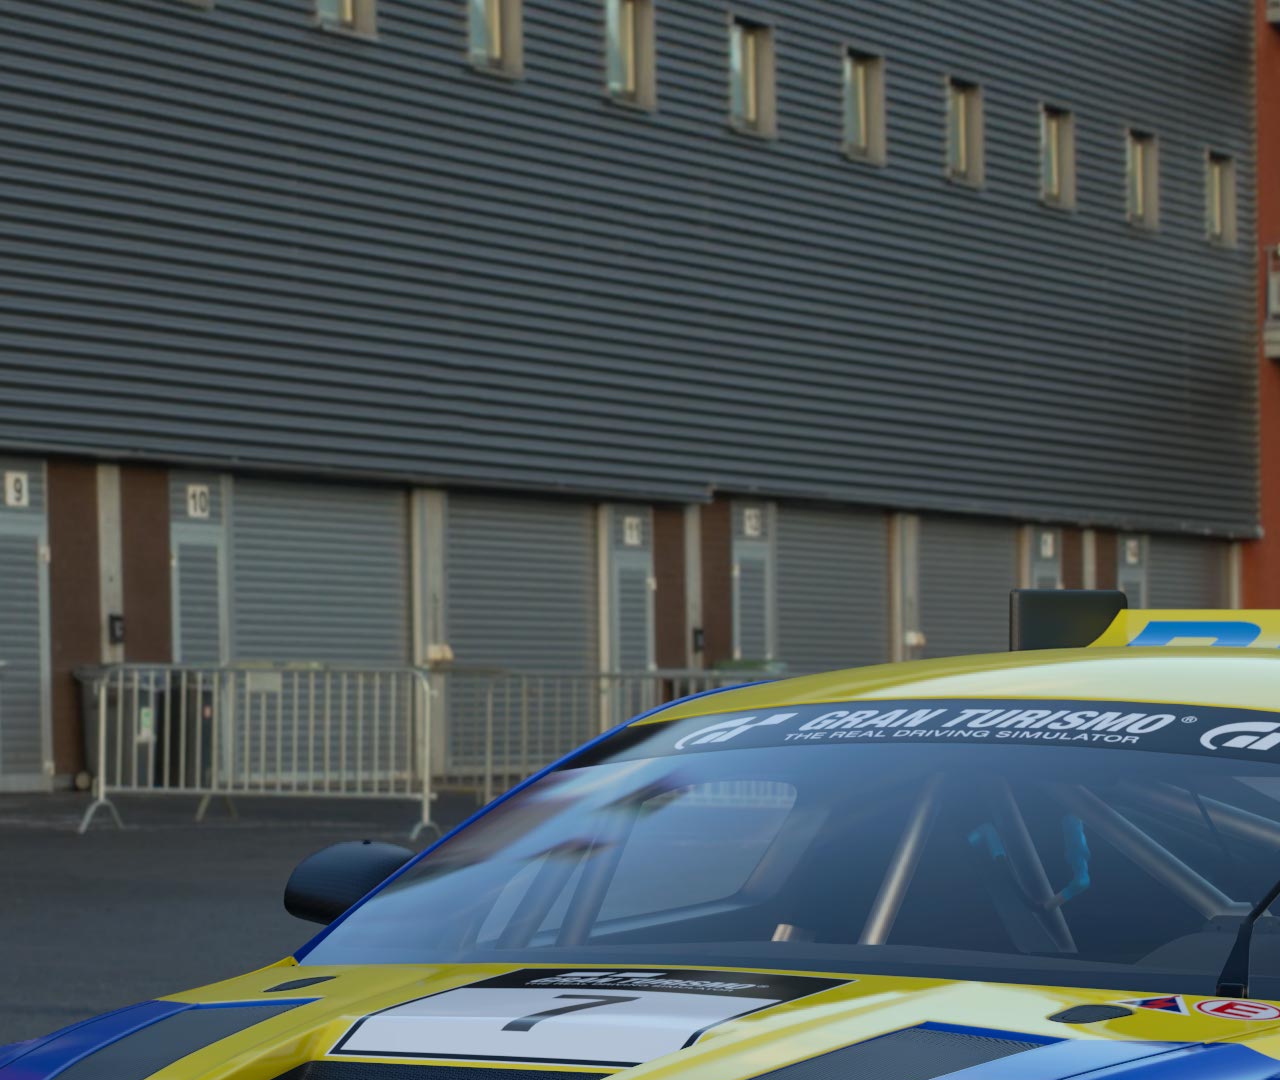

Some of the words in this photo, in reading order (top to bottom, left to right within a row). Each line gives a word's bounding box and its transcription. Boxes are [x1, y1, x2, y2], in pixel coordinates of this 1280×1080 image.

[13, 477, 24, 503] 9
[191, 490, 208, 513] 10
[799, 709, 947, 732] GRAN
[941, 709, 1176, 733] TURISMO
[784, 731, 825, 741] THE
[831, 730, 877, 740] REAL
[893, 729, 989, 738] DRIVING
[995, 730, 1140, 744] SIMULATOR
[501, 994, 642, 1032] 7
